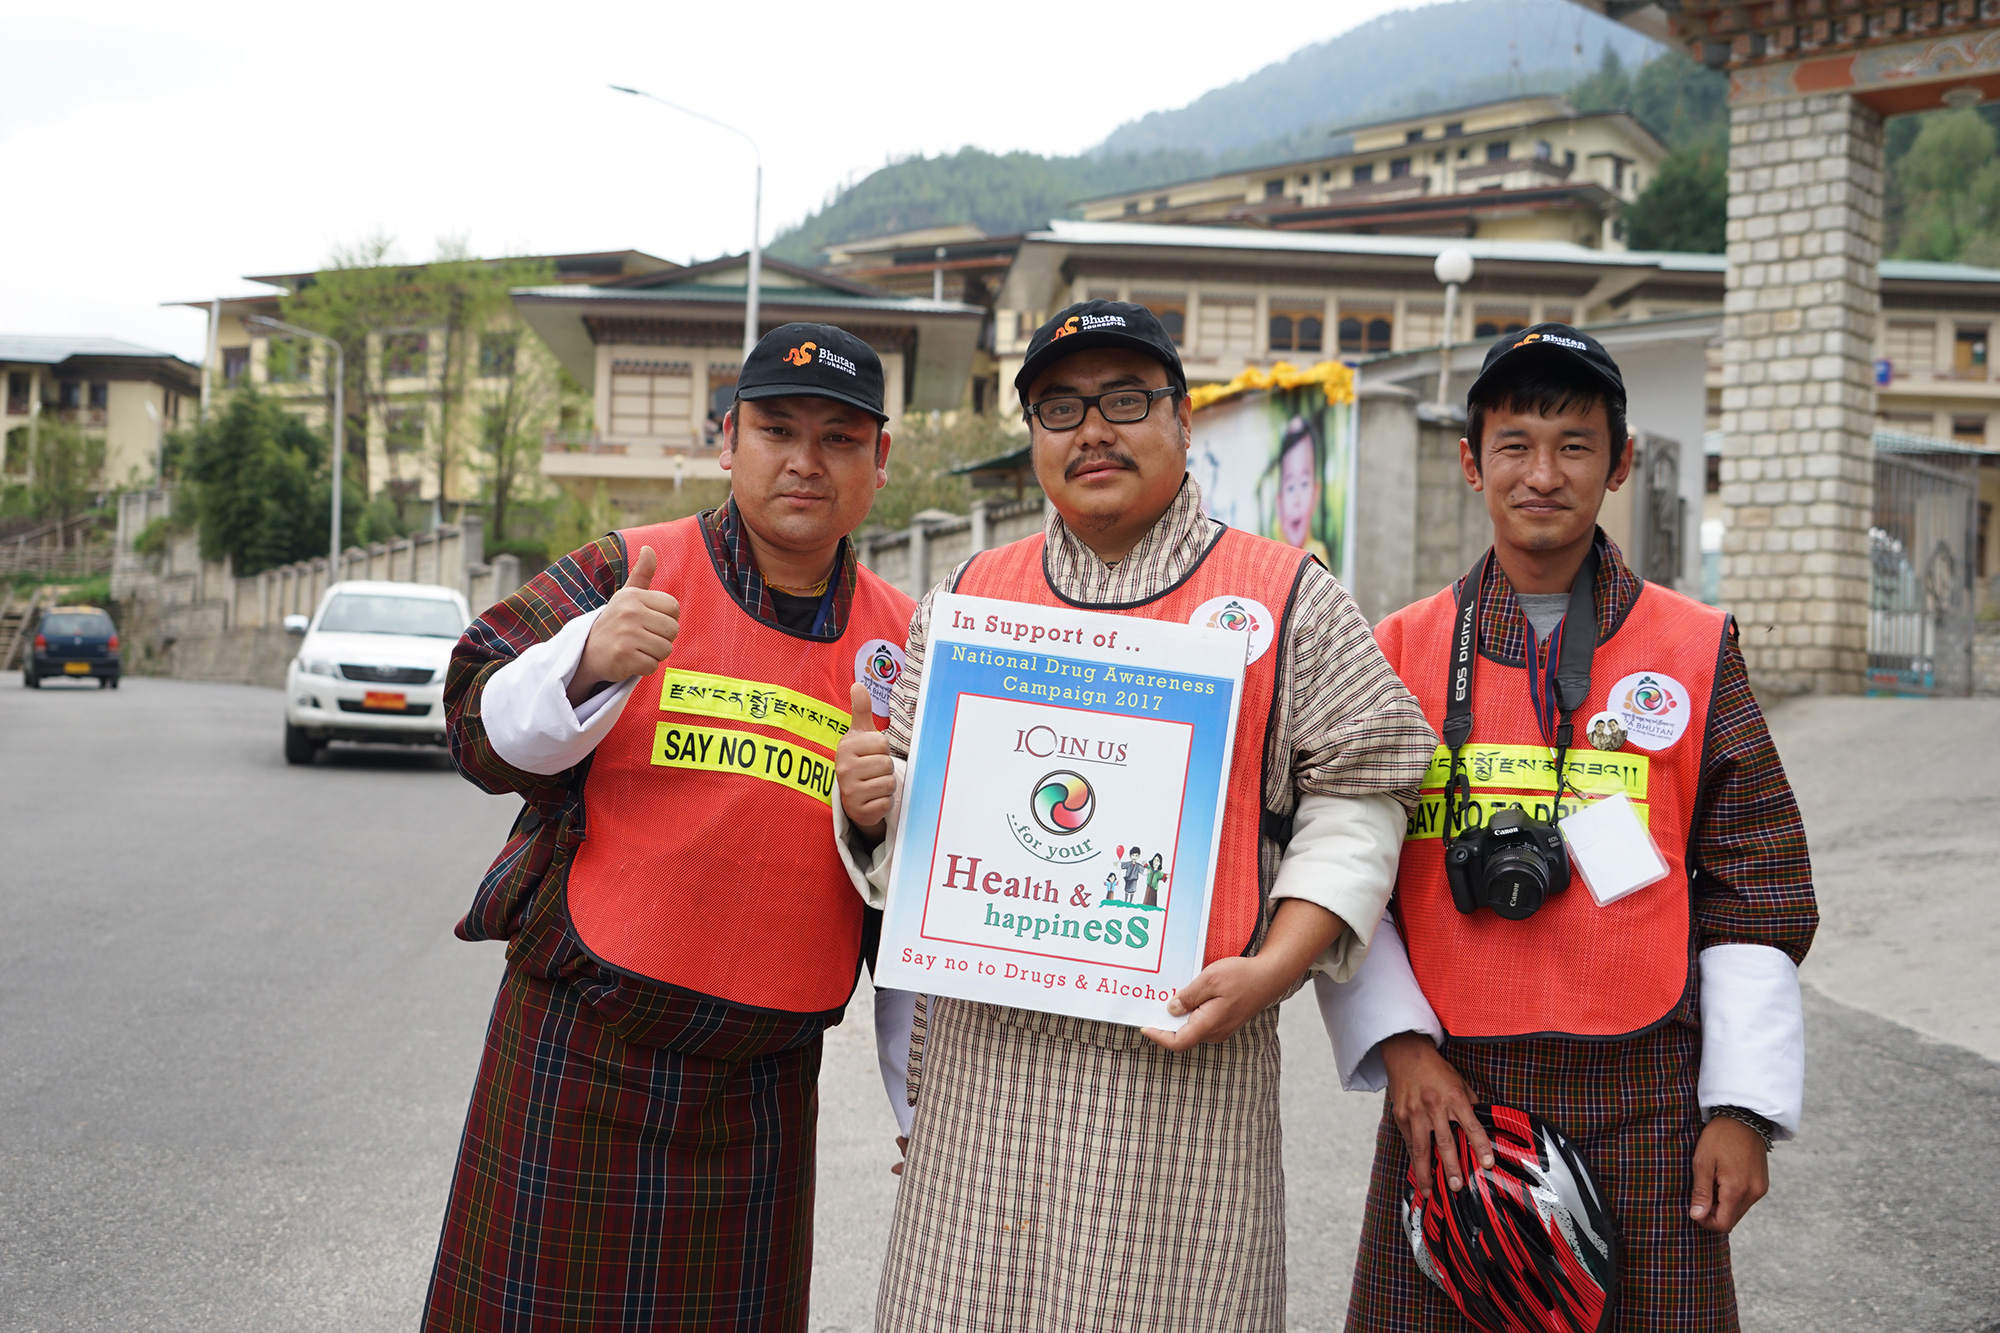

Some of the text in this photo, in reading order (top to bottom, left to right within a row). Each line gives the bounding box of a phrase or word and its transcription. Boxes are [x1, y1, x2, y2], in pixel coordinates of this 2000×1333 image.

[1081, 314, 1126, 326] Bhutan
[1541, 334, 1586, 349] Bhutan
[818, 348, 856, 371] Bhutan
[952, 610, 975, 630] In
[984, 615, 1083, 644] Support
[1455, 600, 1474, 701] EOS DIGITAL
[951, 646, 1215, 695] National Drug Awareness
[1003, 676, 1163, 711] Campaign 2017
[1014, 725, 1128, 762] JOIN US
[1636, 722, 1674, 736] BHUTAN
[664, 729, 713, 763] SAY
[718, 736, 756, 768] NO
[764, 745, 793, 778] TO
[1494, 827, 1519, 836] Canon
[1045, 839, 1093, 859] your
[942, 854, 1092, 908] Health &
[1509, 883, 1520, 907] Canon
[983, 903, 1150, 949] happiness
[902, 948, 938, 970] Say
[944, 956, 968, 971] no
[977, 960, 996, 975] to
[1004, 963, 1066, 988] Drugs
[1075, 974, 1088, 990] &
